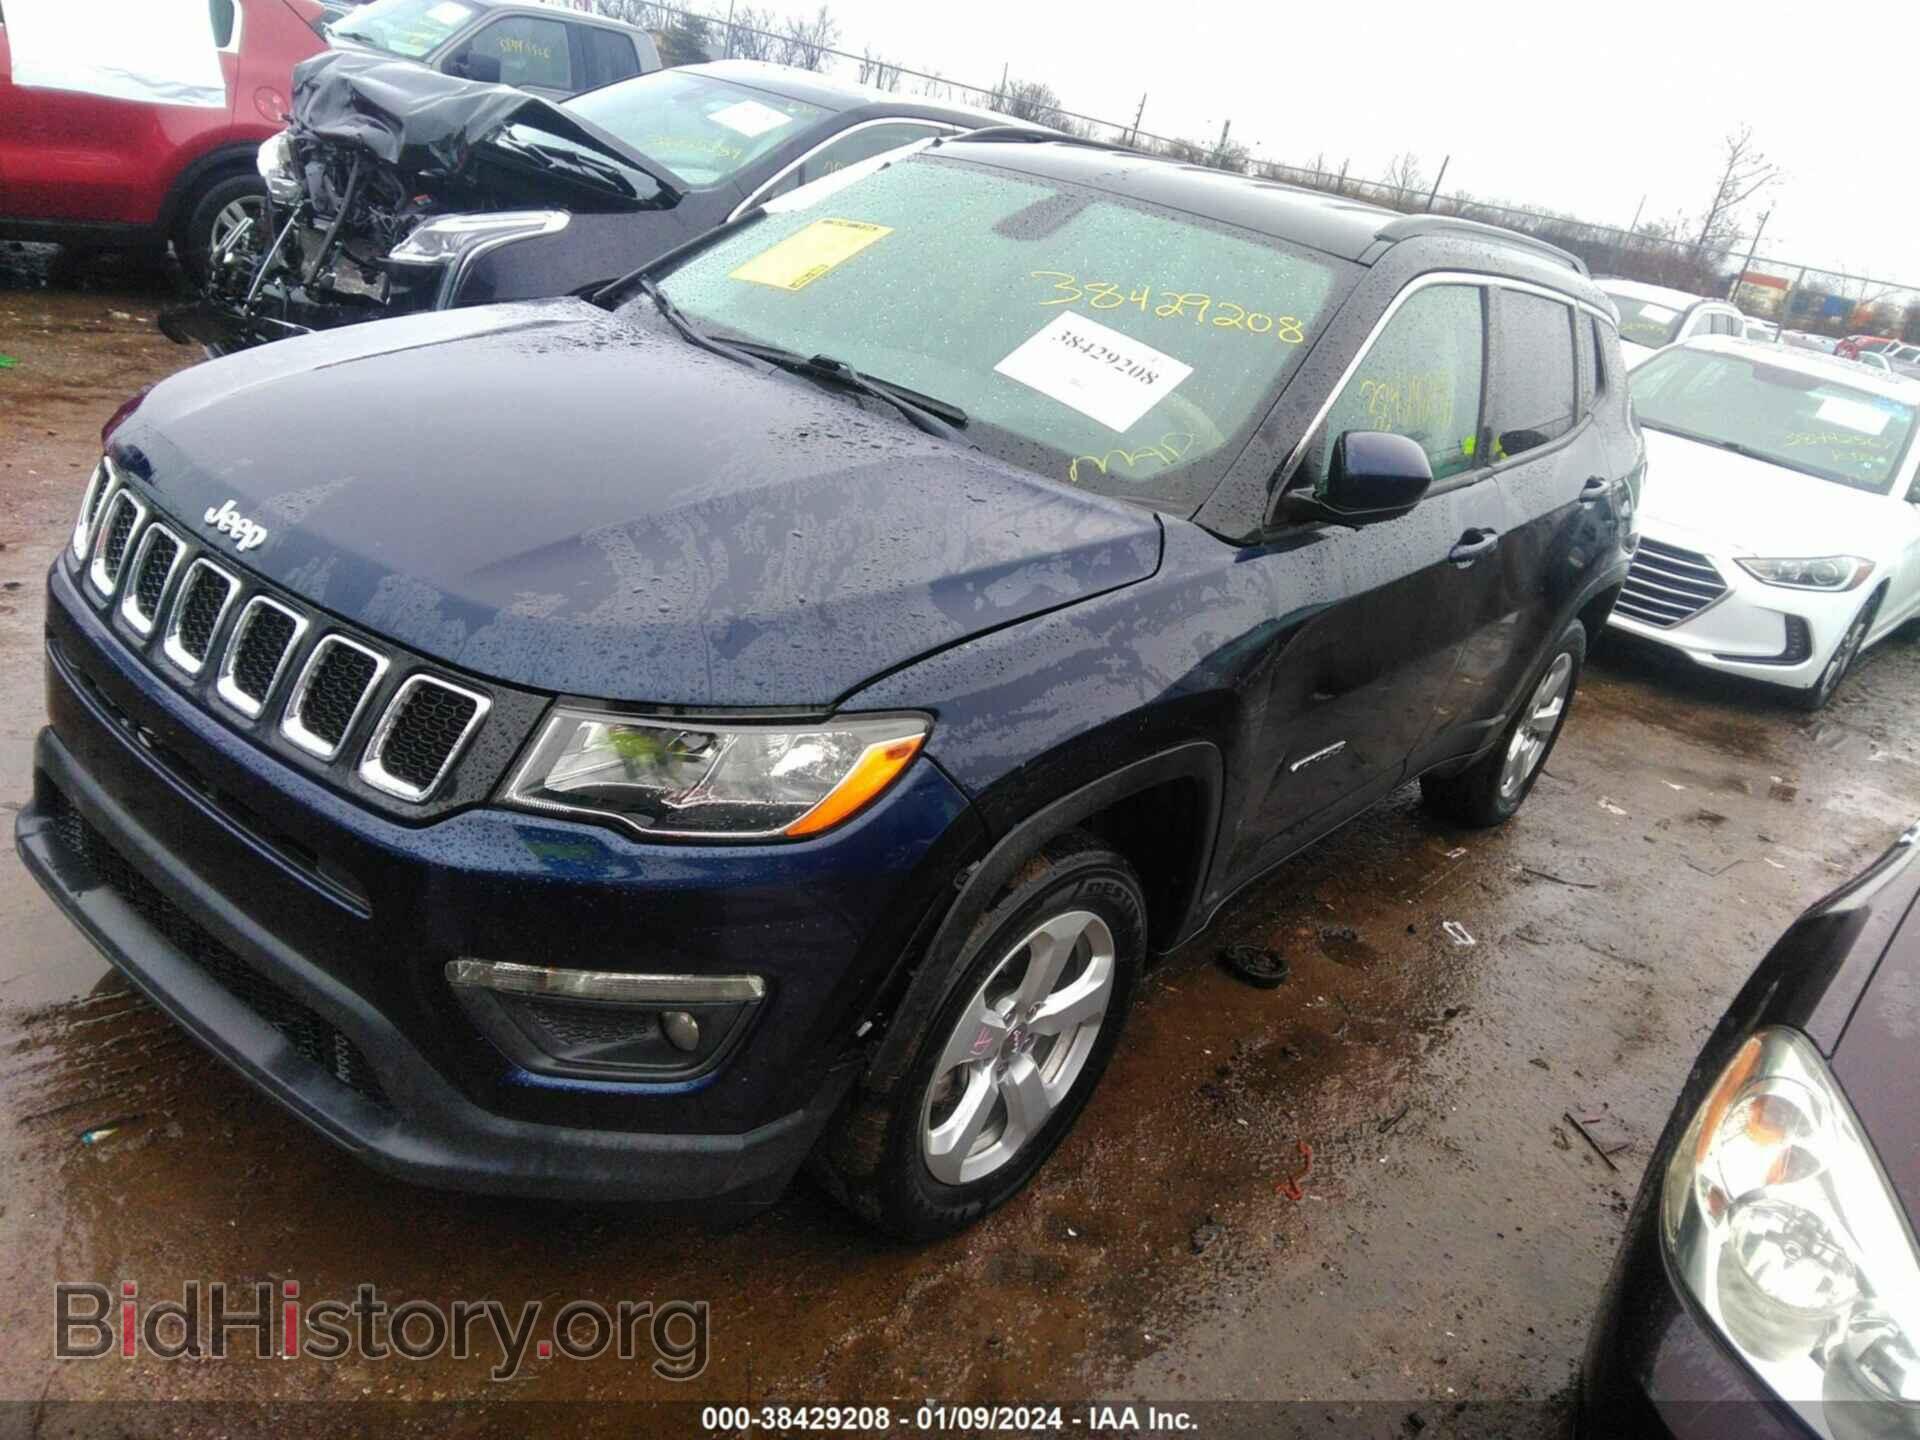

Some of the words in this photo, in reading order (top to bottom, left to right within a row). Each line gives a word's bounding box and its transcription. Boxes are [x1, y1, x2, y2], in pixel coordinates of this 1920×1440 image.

[1031, 271, 1304, 343] 38429208
[1052, 329, 1160, 386] 38429208
[204, 499, 268, 552] Jeep
